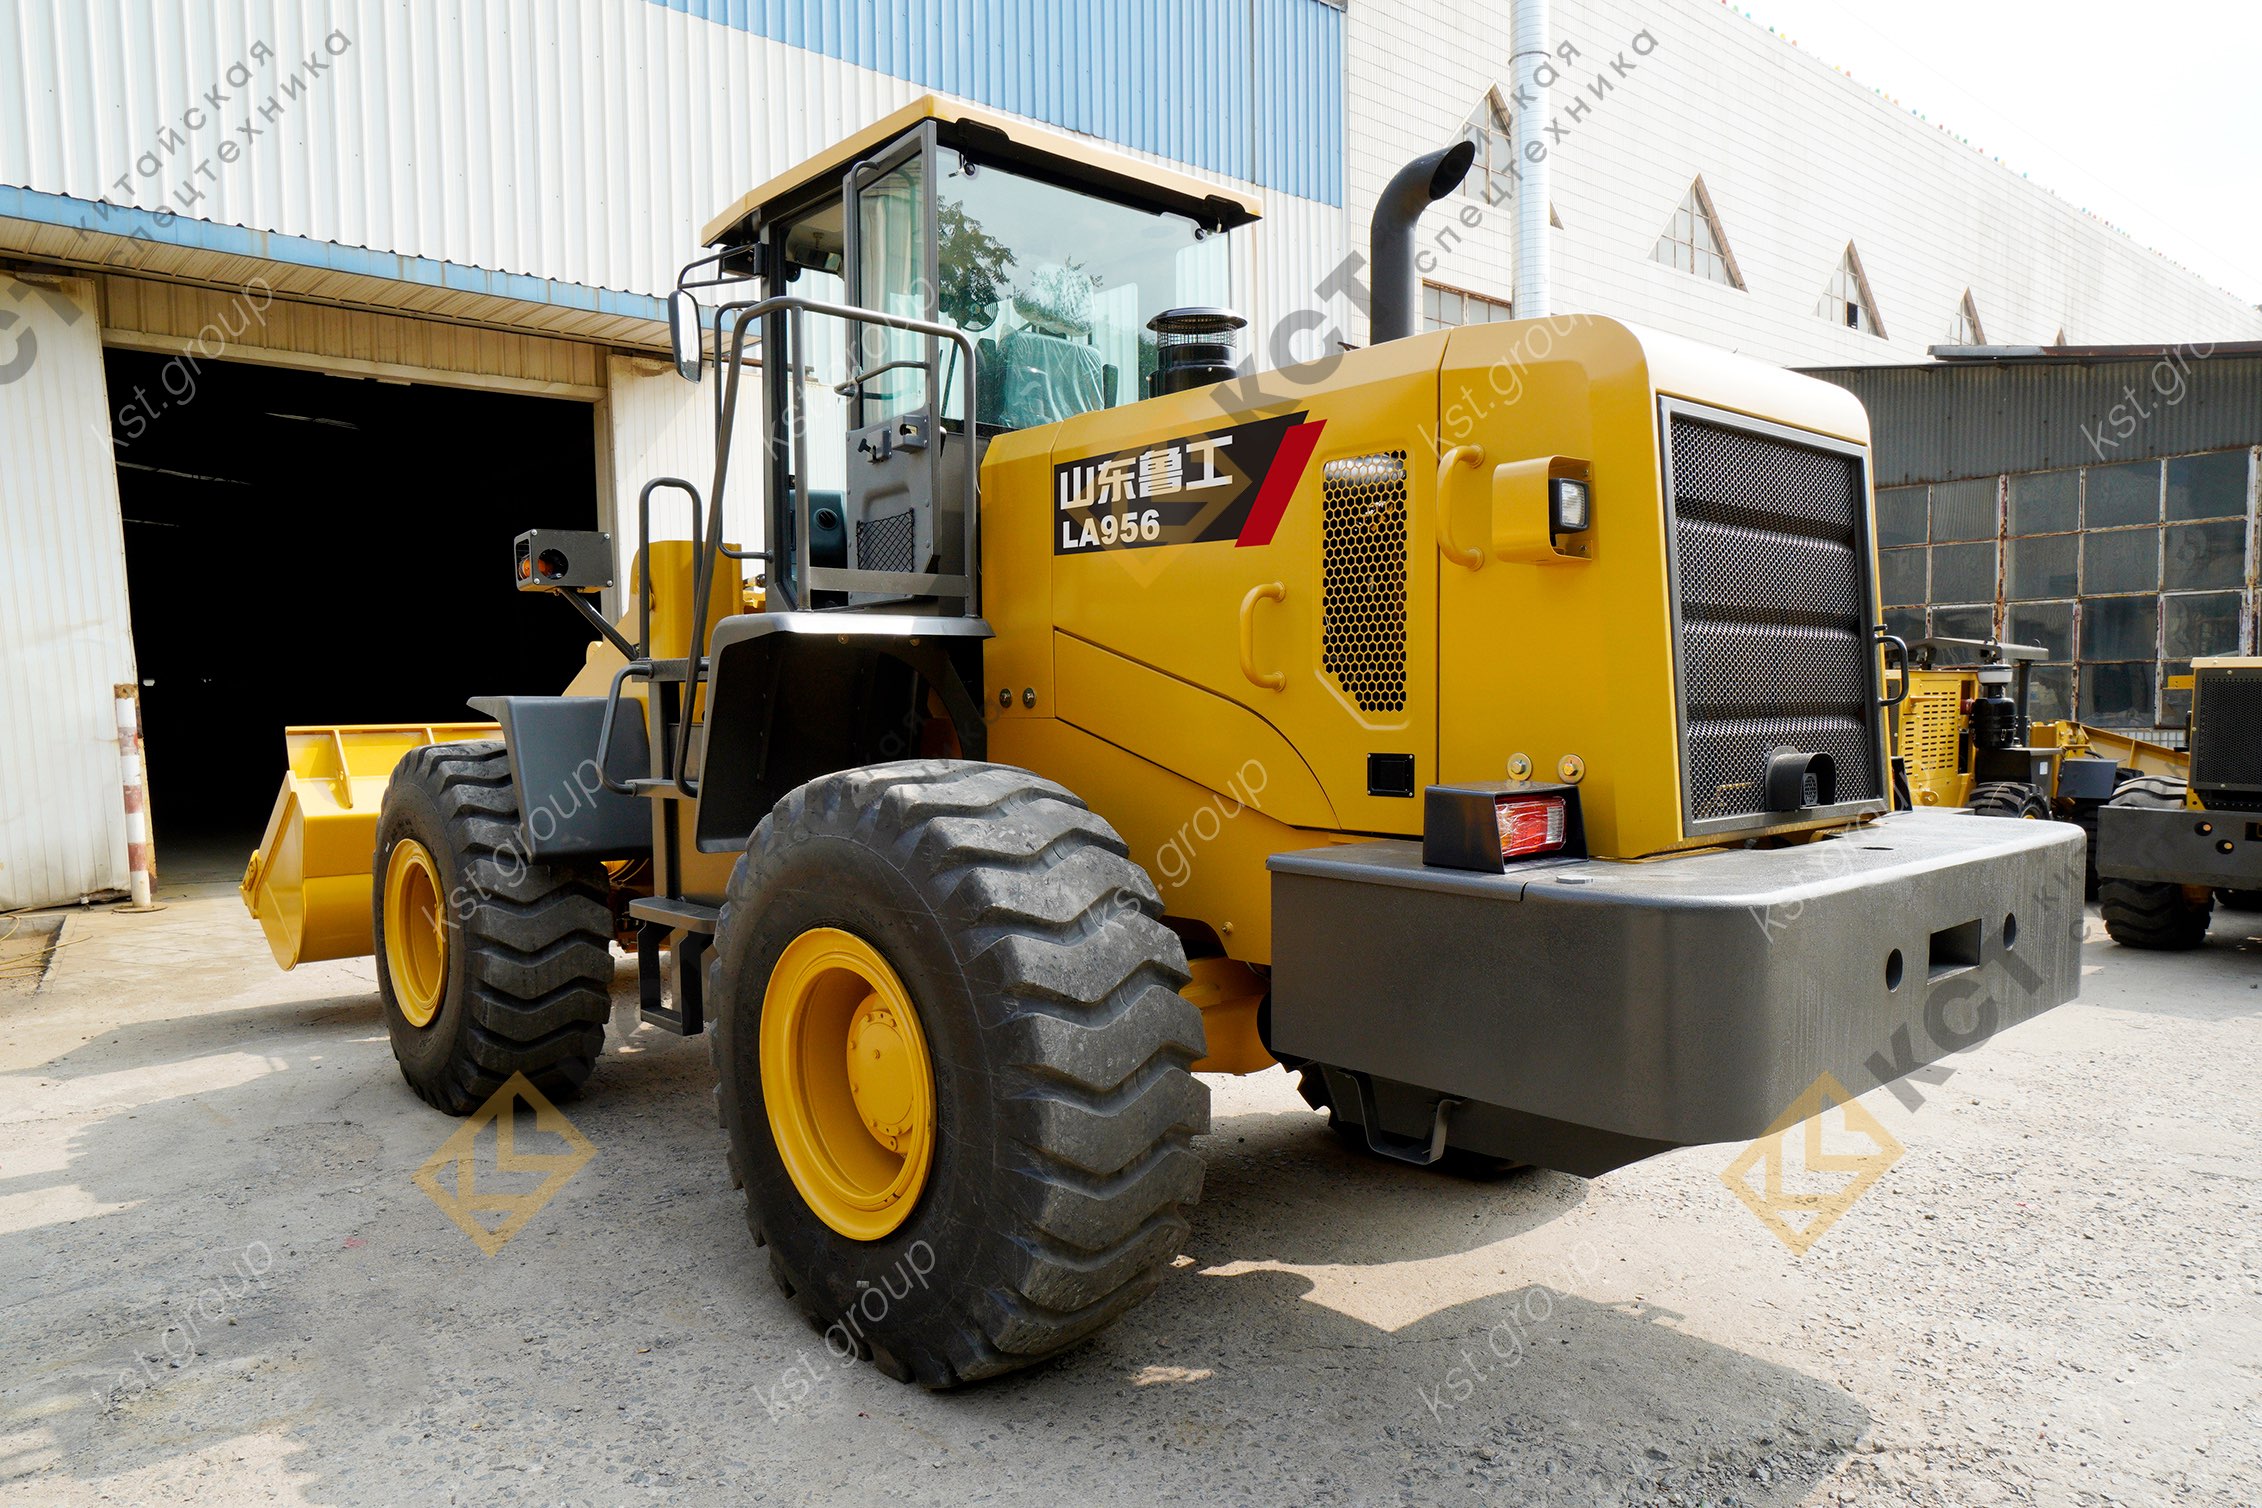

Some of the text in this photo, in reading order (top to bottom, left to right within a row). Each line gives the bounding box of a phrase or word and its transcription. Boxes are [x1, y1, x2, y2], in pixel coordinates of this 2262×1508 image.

[1060, 435, 1233, 510] 山东鲁工
[1062, 509, 1160, 549] LA956
